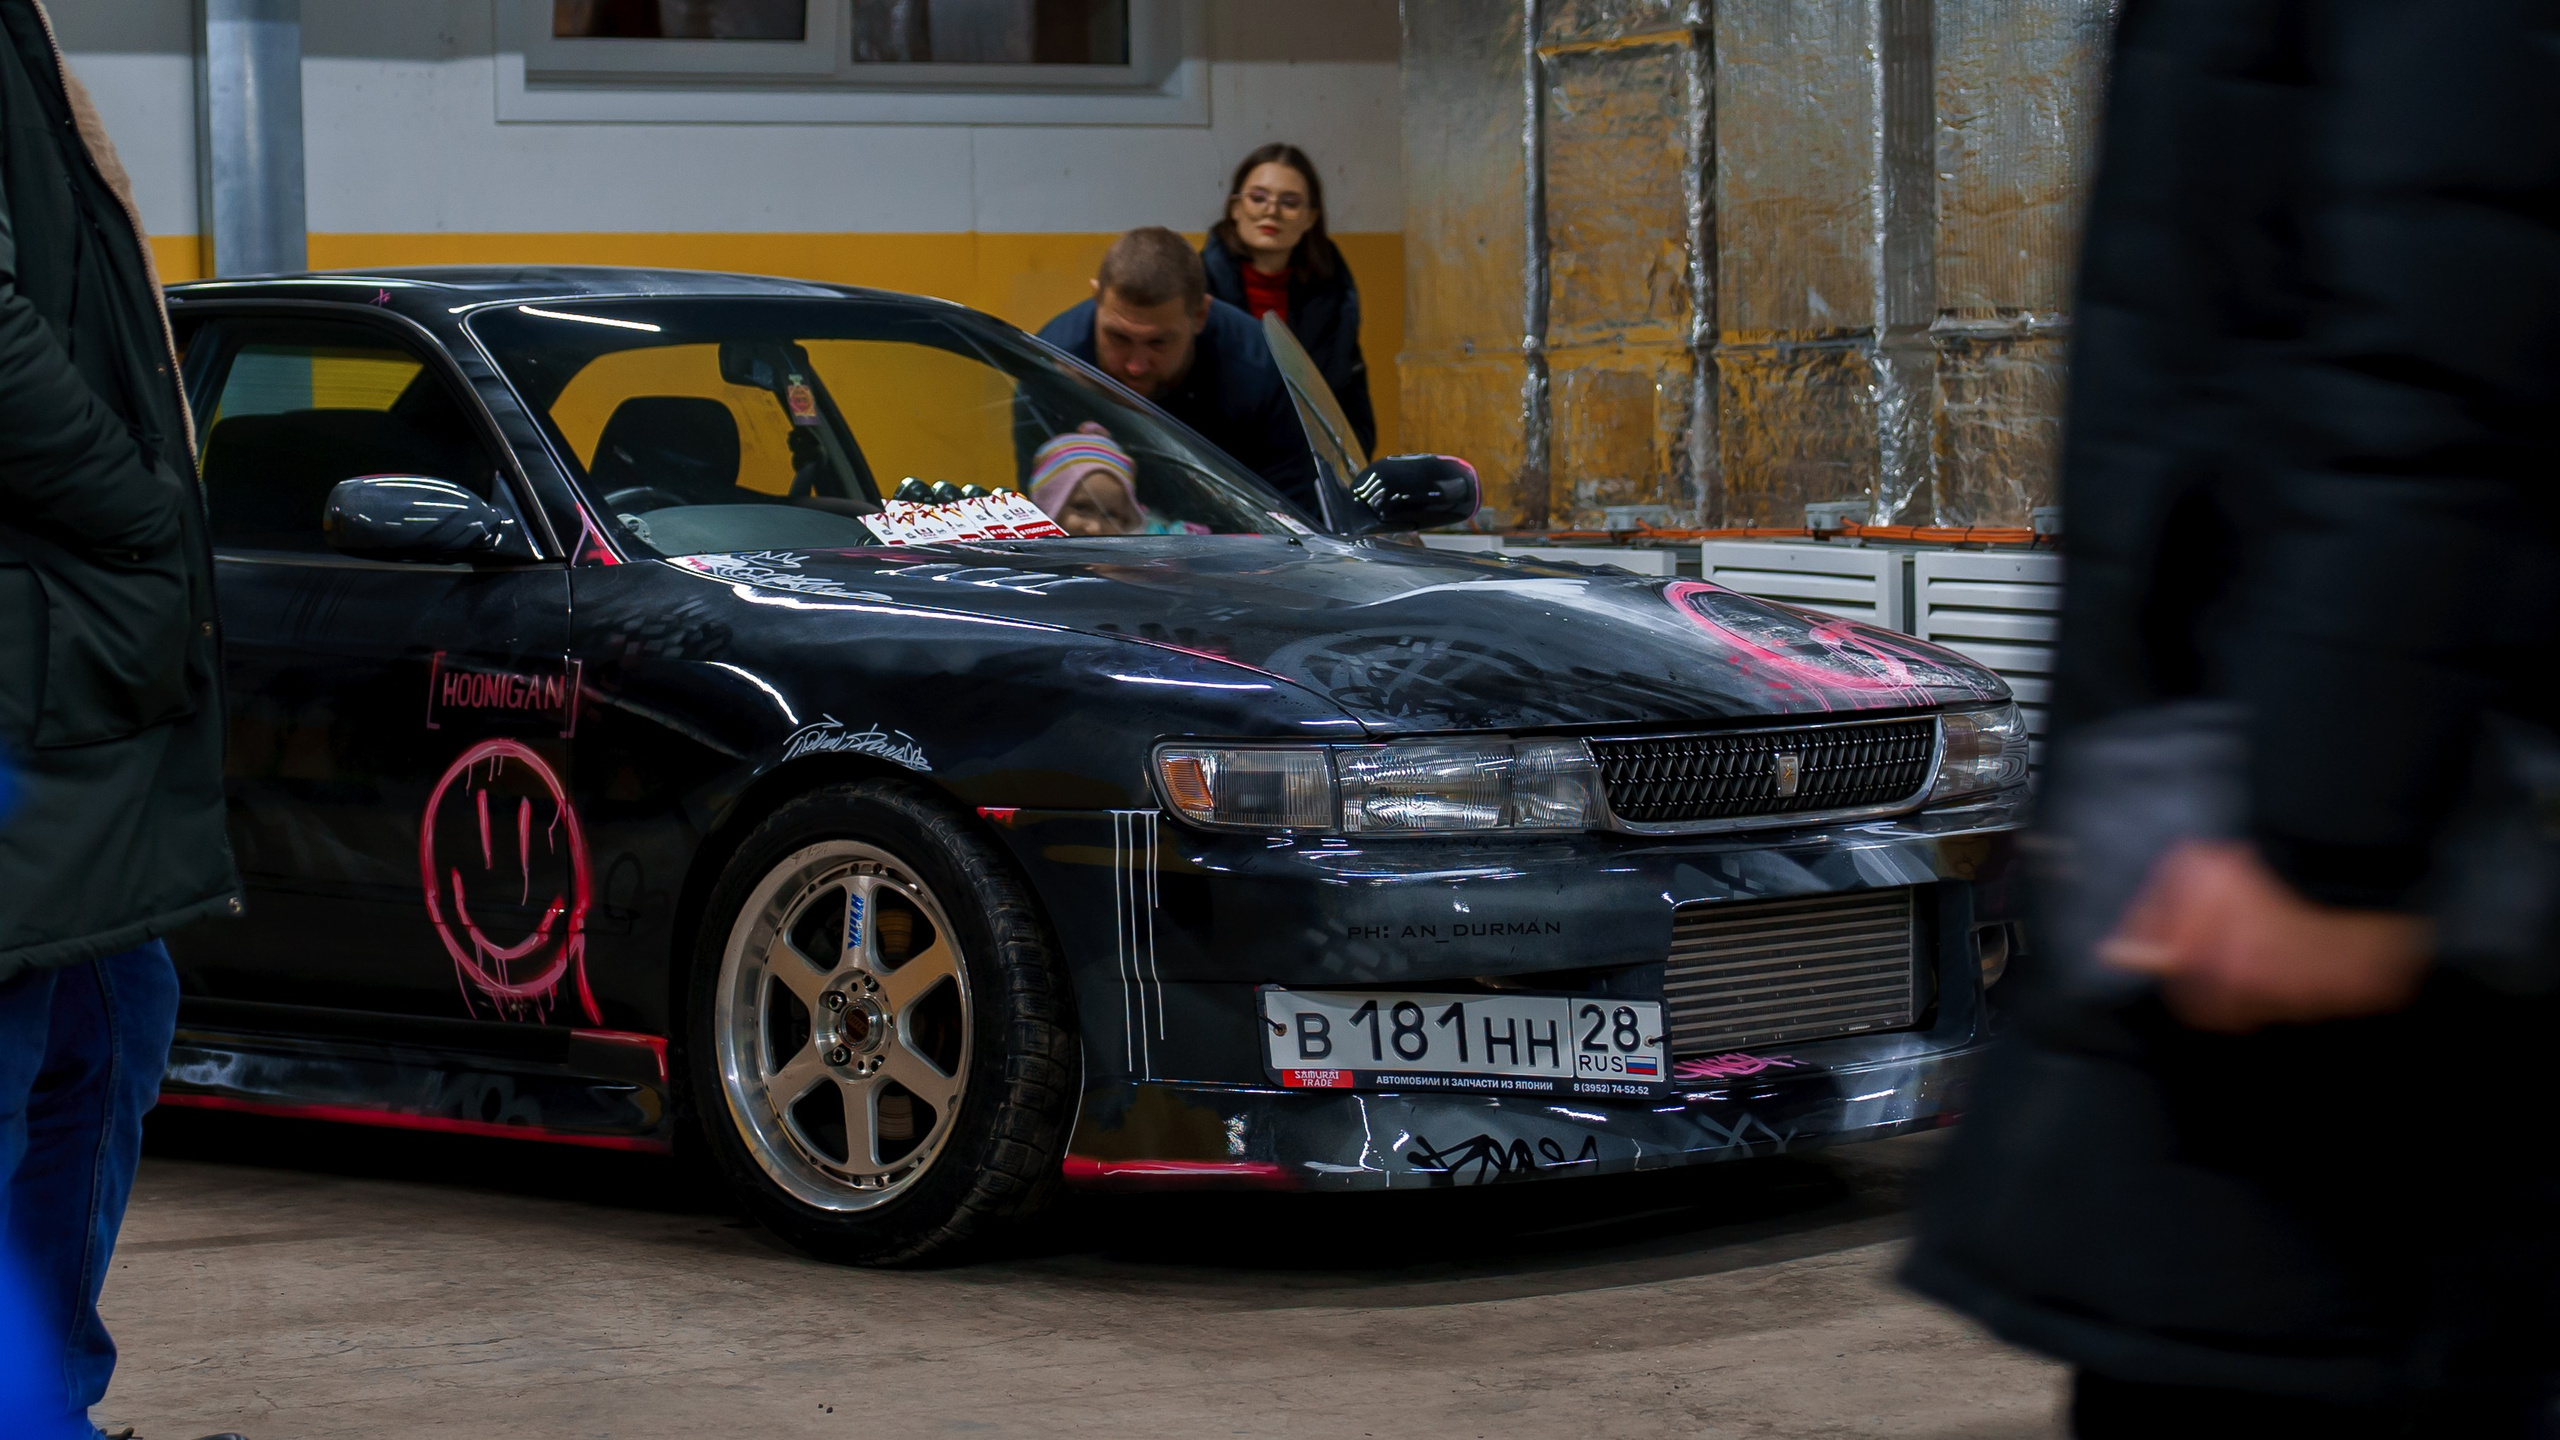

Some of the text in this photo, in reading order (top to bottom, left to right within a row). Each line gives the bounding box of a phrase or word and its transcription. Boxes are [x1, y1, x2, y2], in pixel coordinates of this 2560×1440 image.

[442, 672, 566, 710] HOONIGAN
[1348, 921, 1561, 943] PH: AN_DURMAN
[1348, 1000, 1469, 1063] 181
[1578, 1003, 1641, 1053] 28
[1579, 1055, 1624, 1073] RUS
[1294, 1070, 1339, 1080] SAMURAI
[1302, 1078, 1333, 1087] TRADE
[1376, 1075, 1553, 1091] АВТОМОБИЛИ И ЗАПЧАСТИ ИЗ ЯПОНИИ
[1573, 1083, 1649, 1095] 8 (3952) 74-52-52
